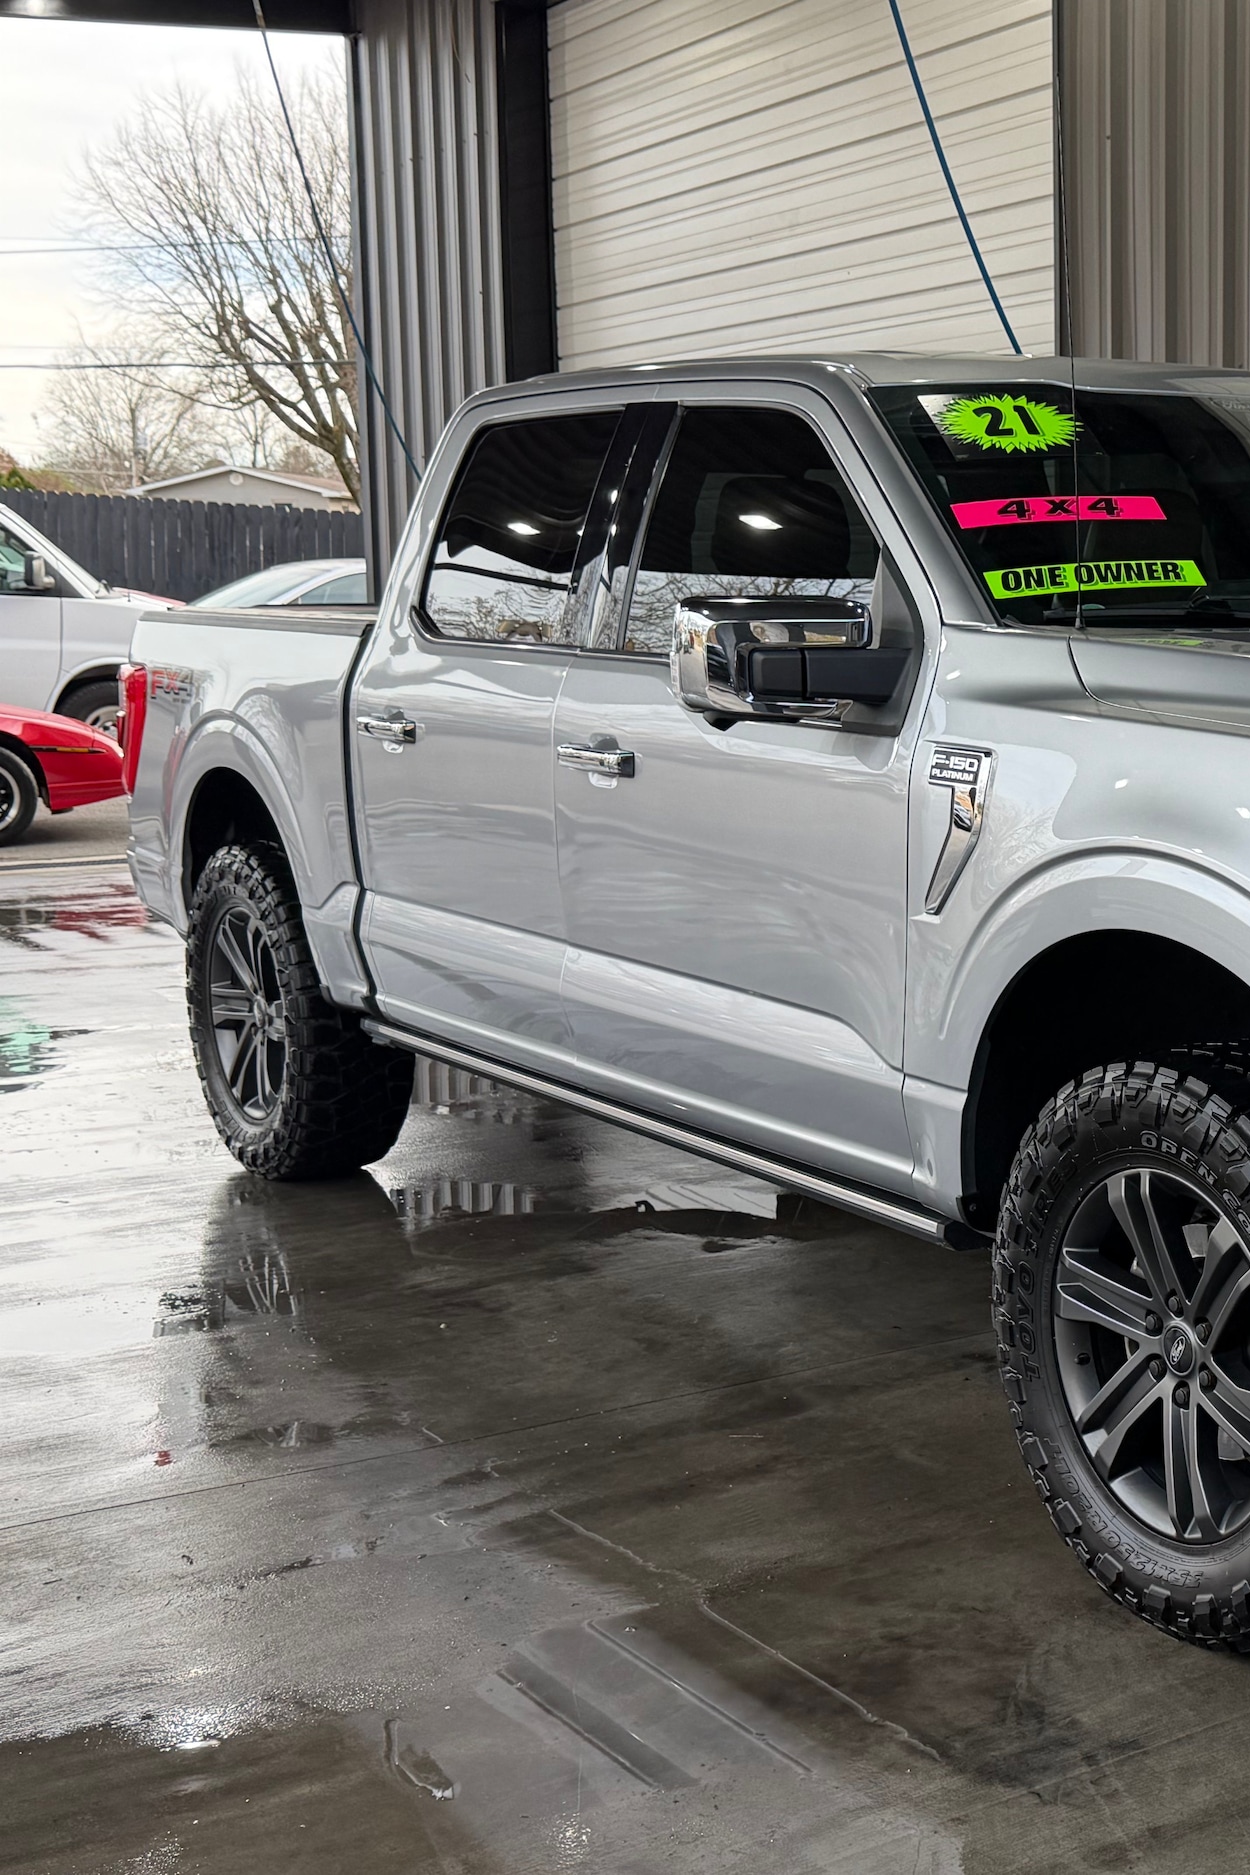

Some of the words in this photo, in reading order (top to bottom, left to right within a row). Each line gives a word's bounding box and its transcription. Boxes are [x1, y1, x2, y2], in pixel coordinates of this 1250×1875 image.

[973, 405, 1044, 437] 21
[1001, 566, 1070, 593] ONE
[1074, 561, 1184, 585] OWNER
[931, 768, 974, 782] PLATINUM
[932, 754, 978, 771] F-150
[1140, 1130, 1218, 1185] OPEN
[1017, 1261, 1040, 1381] TOYO
